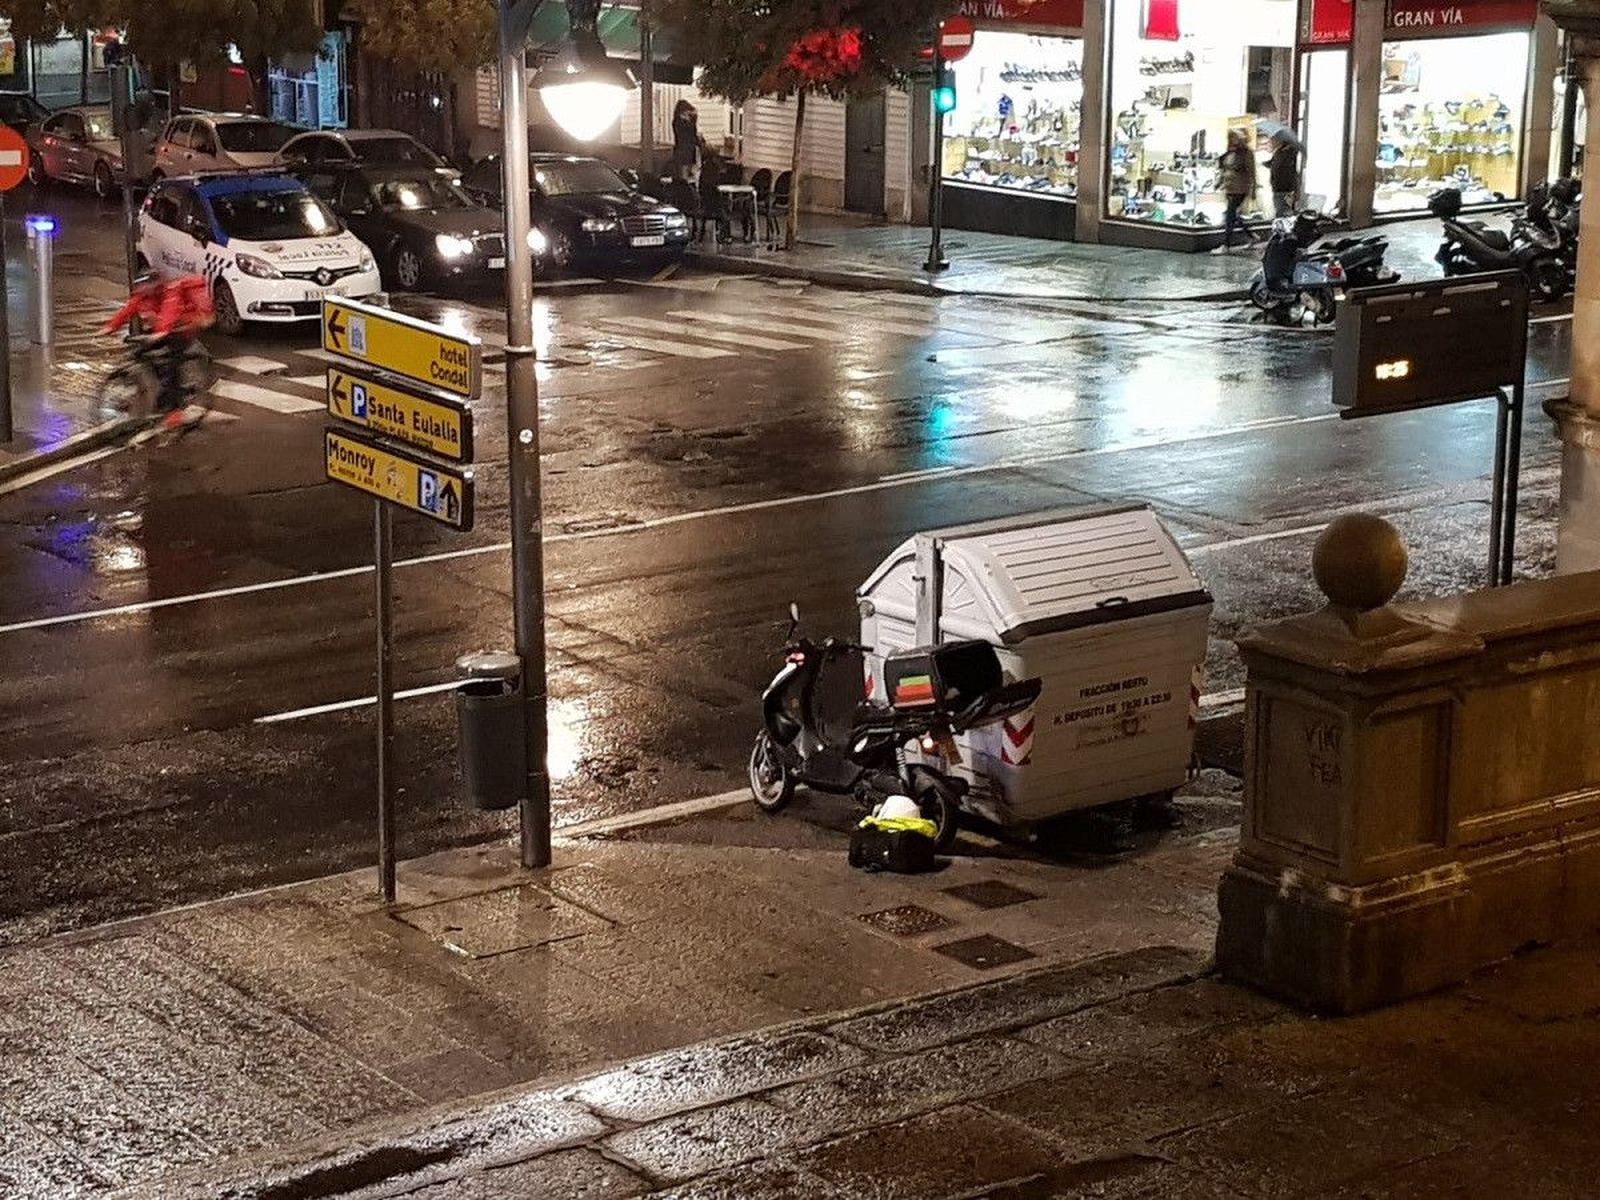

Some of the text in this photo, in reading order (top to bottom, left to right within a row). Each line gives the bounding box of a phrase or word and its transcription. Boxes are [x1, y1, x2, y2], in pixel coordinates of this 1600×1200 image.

[1394, 11, 1435, 27] GRAN
[440, 342, 468, 368] hotel
[430, 360, 468, 389] Condal
[368, 395, 405, 425] Santa
[412, 409, 458, 443] Eulalia
[329, 438, 376, 476] Monroy
